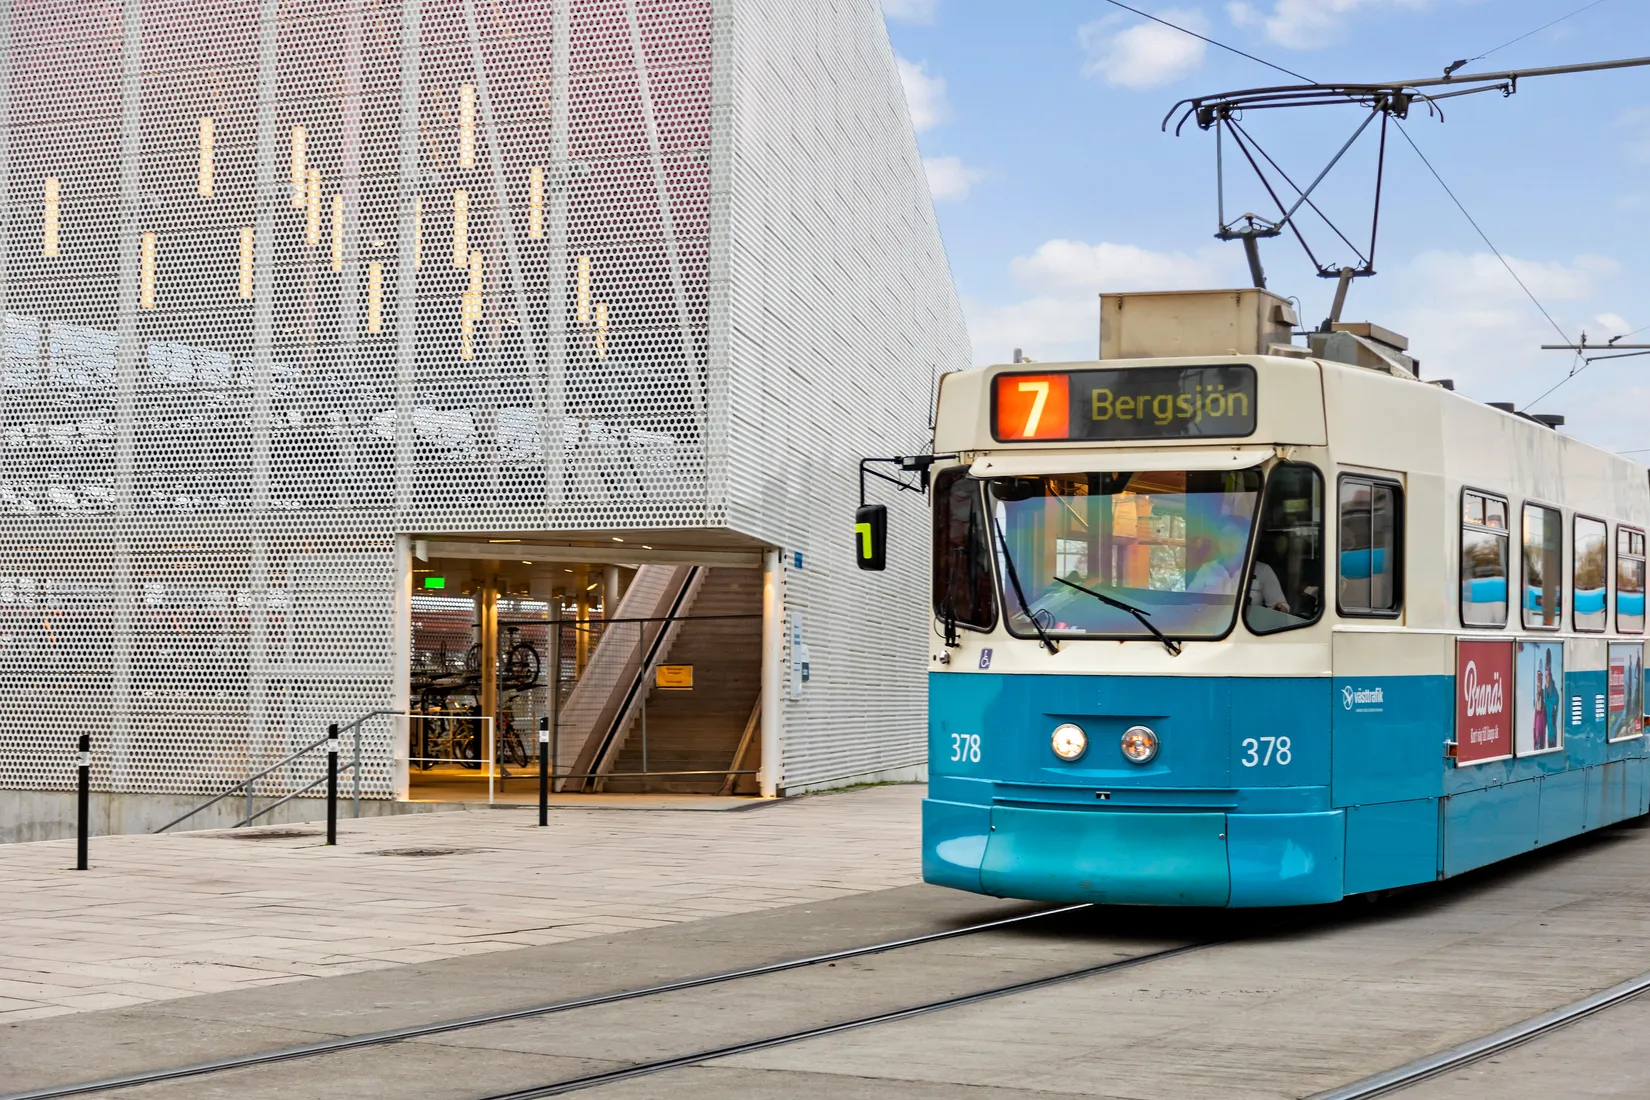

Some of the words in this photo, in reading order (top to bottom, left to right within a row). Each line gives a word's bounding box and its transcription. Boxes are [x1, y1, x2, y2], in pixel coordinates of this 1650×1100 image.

[1018, 381, 1049, 438] 7
[1091, 384, 1249, 426] Bergsjön
[1353, 687, 1384, 704] västtrafik
[1464, 660, 1503, 717] Branäs
[950, 733, 981, 763] 378
[1241, 736, 1292, 767] 378
